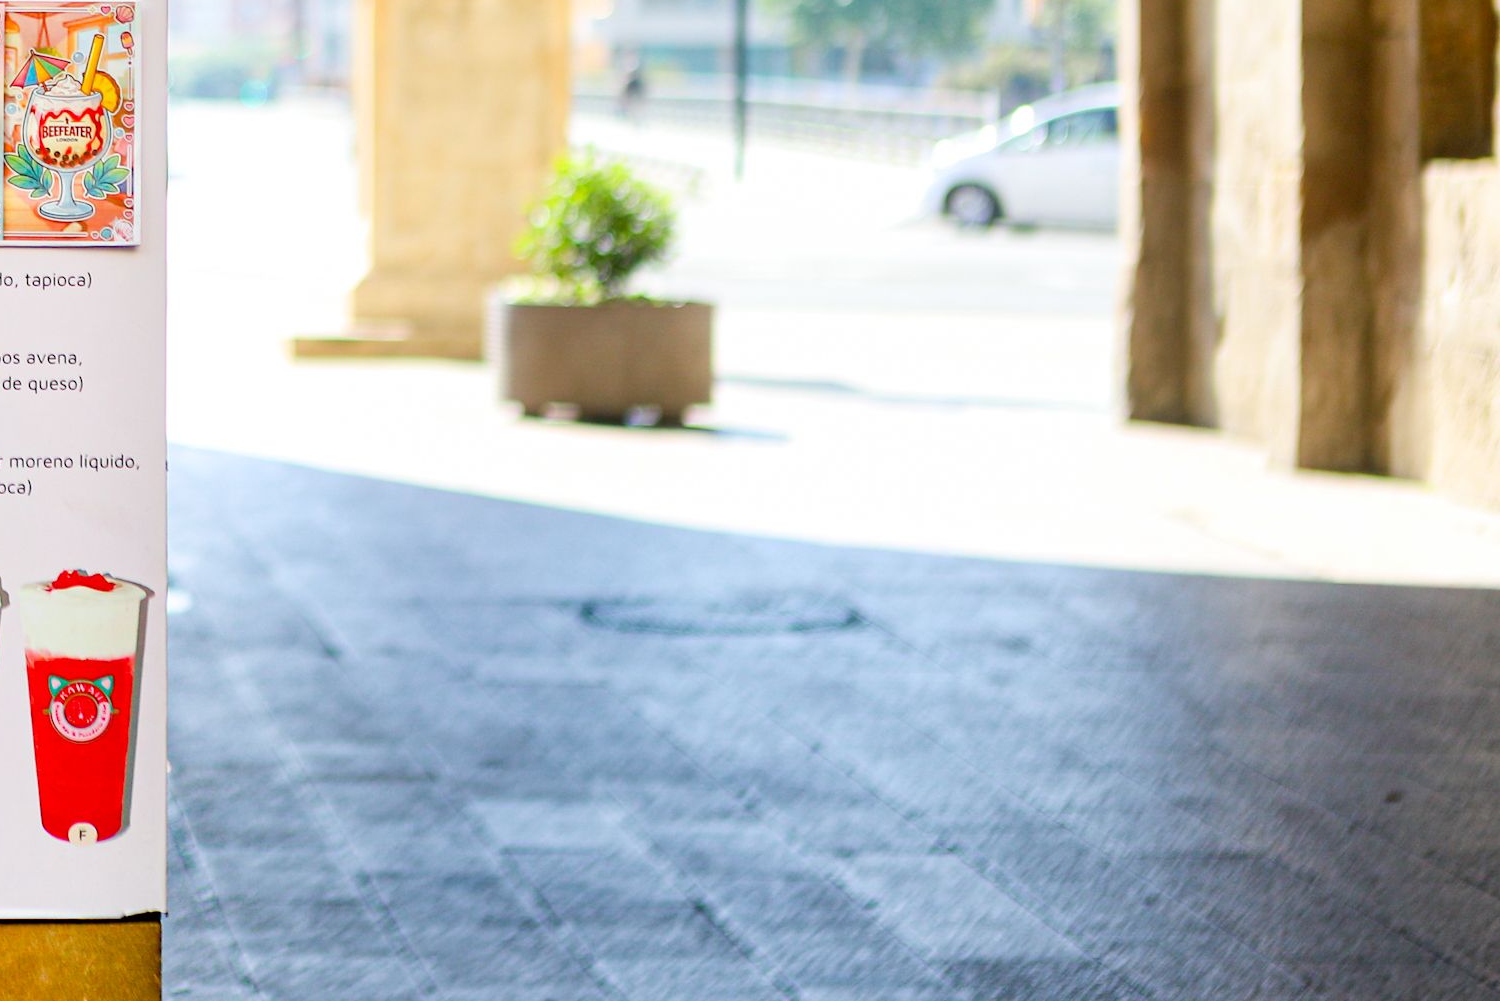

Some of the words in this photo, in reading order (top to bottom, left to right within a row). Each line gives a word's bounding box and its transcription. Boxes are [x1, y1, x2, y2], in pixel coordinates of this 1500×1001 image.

[42, 125, 93, 139] BEEFEATER
[24, 272, 92, 291] tapioca)
[79, 829, 87, 841] F
